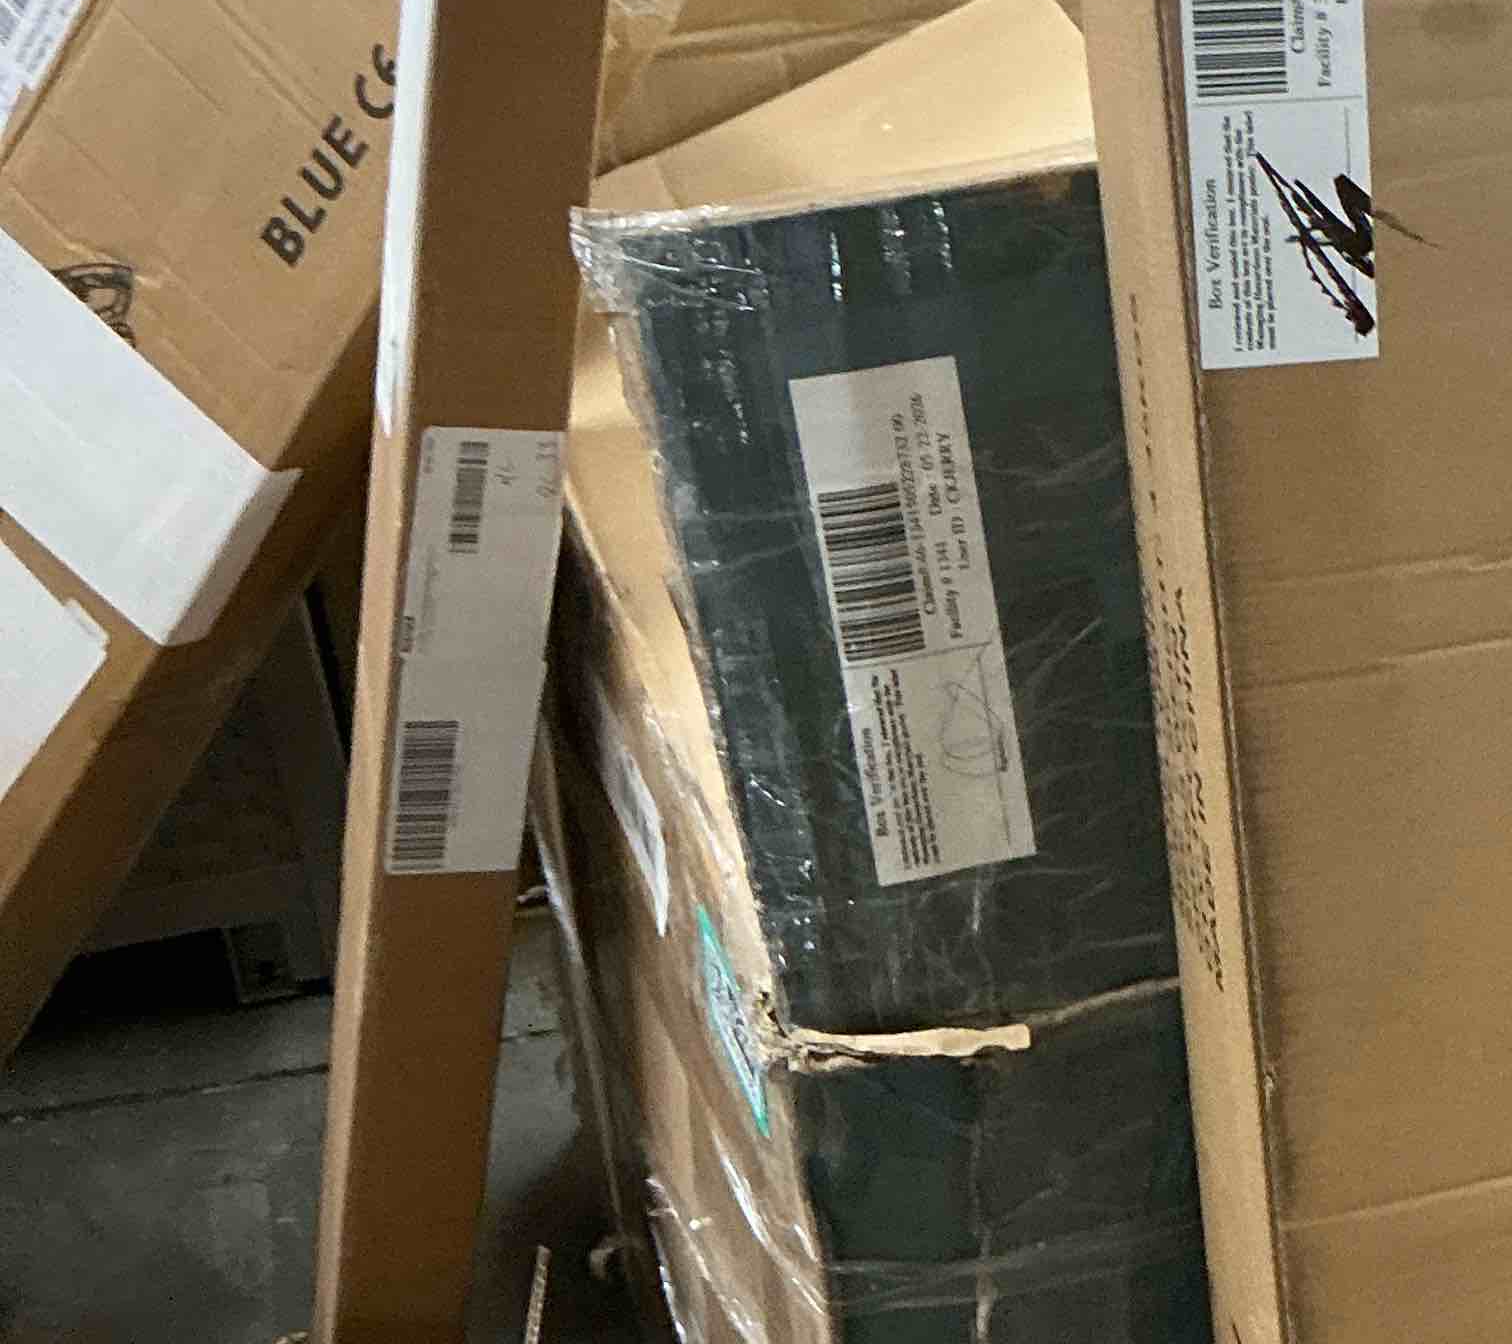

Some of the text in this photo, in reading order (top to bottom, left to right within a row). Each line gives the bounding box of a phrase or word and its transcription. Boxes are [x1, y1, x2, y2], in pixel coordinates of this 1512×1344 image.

[1314, 25, 1335, 88] Facility
[259, 113, 369, 268] BLUE
[1199, 177, 1223, 310] Box Verification
[858, 725, 885, 807] Verification
